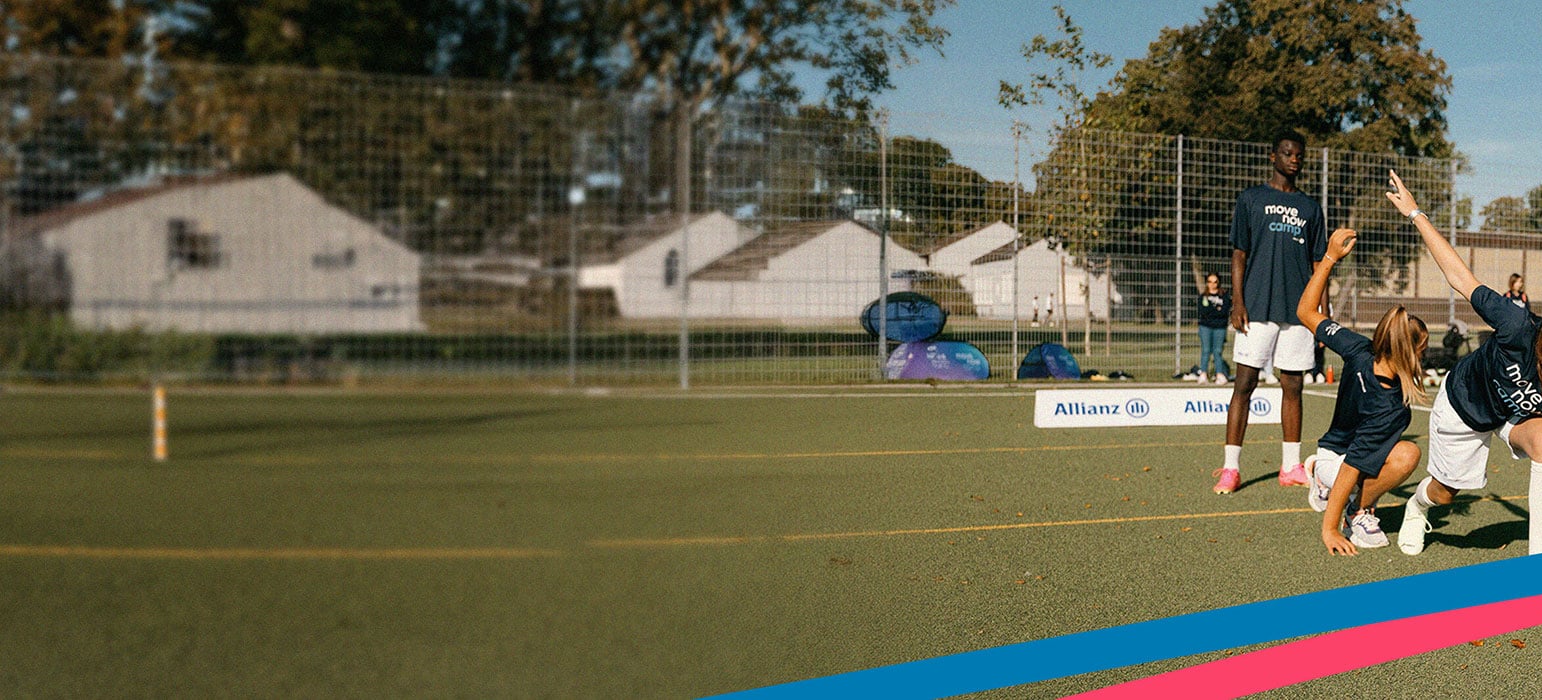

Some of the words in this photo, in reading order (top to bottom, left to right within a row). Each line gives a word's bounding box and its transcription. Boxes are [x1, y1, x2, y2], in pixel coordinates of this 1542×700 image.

[1264, 204, 1299, 217] move
[1282, 214, 1307, 228] now
[1269, 221, 1302, 237] camp
[1506, 363, 1542, 406] move
[1054, 402, 1120, 416] Allianz
[1184, 400, 1231, 413] Allia
